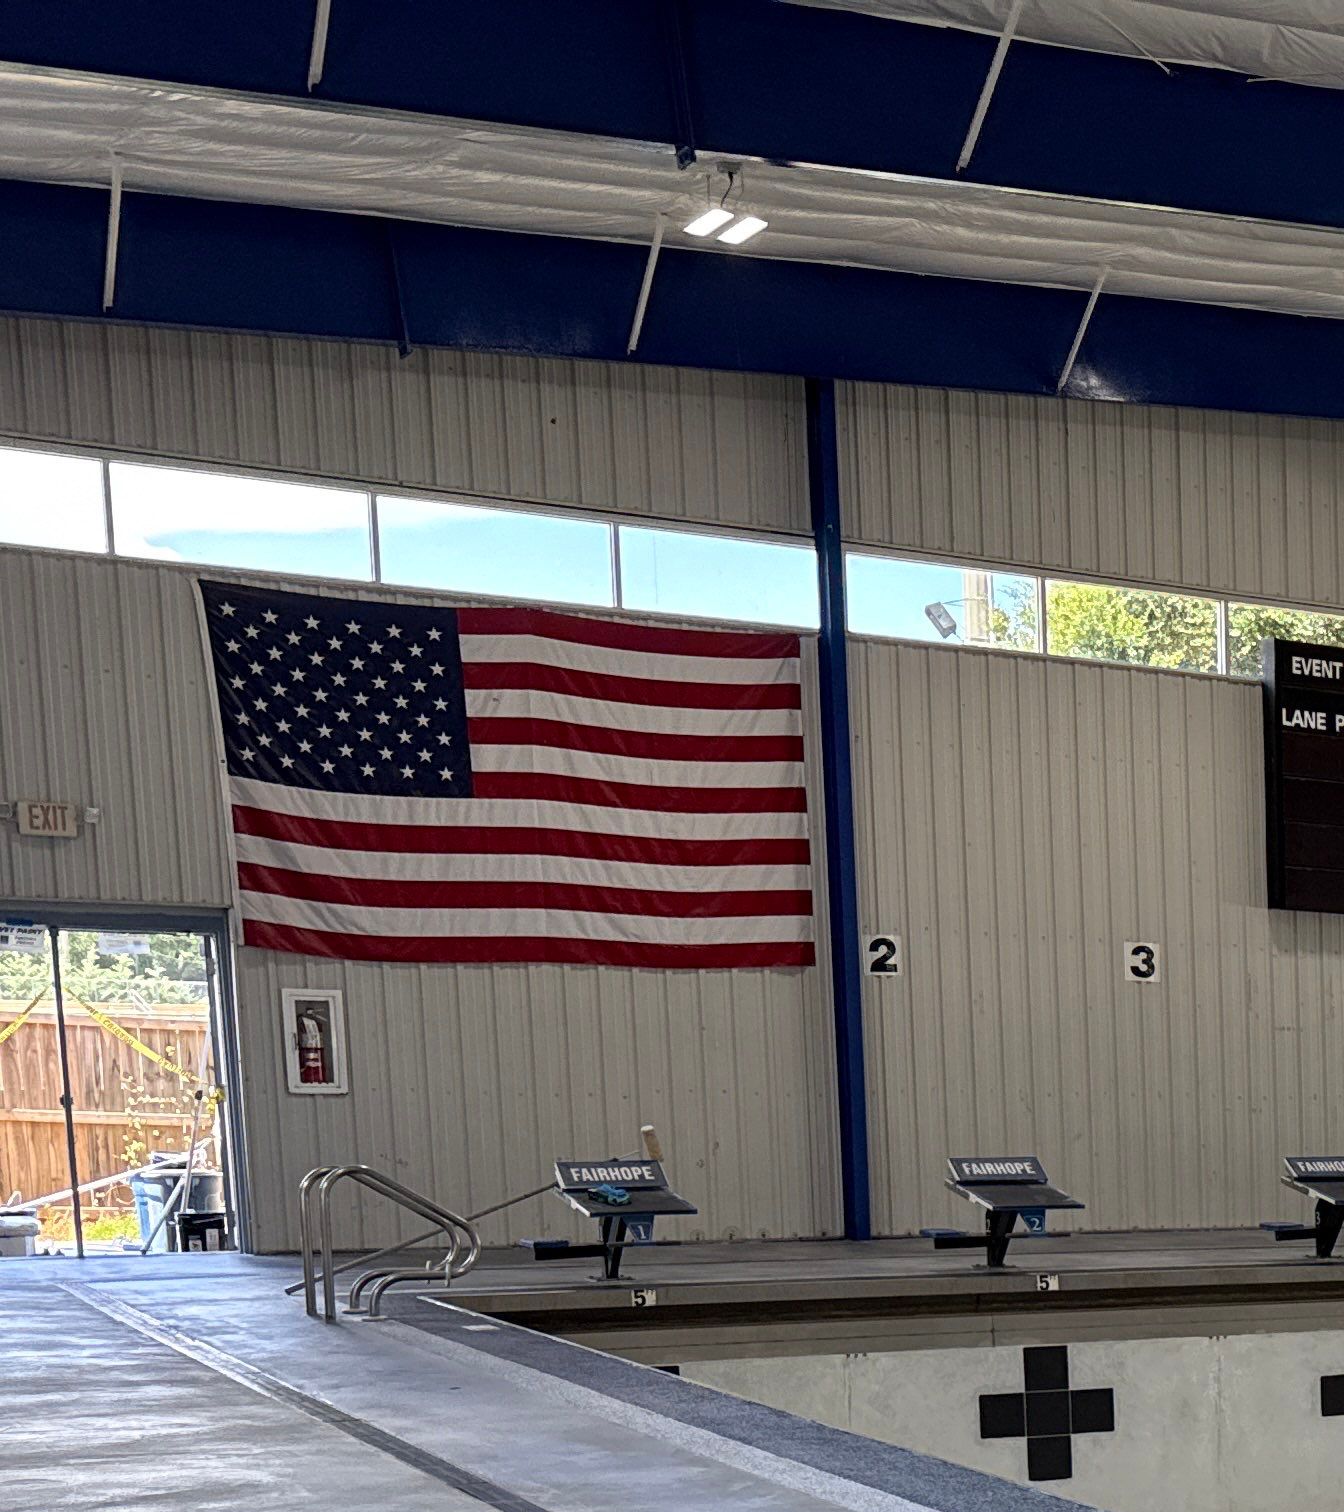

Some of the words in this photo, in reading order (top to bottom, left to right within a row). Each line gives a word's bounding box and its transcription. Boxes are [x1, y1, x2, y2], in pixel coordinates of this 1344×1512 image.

[1291, 656, 1344, 680] EVENT
[1281, 707, 1327, 731] LANE
[28, 804, 68, 832] EXIT
[869, 938, 898, 973] 2
[1130, 945, 1156, 979] 3
[570, 1166, 656, 1182] FAIRHOPE
[961, 1161, 1037, 1175] FAIRHOPE
[637, 1224, 647, 1240] 1
[1030, 1217, 1042, 1231] 2
